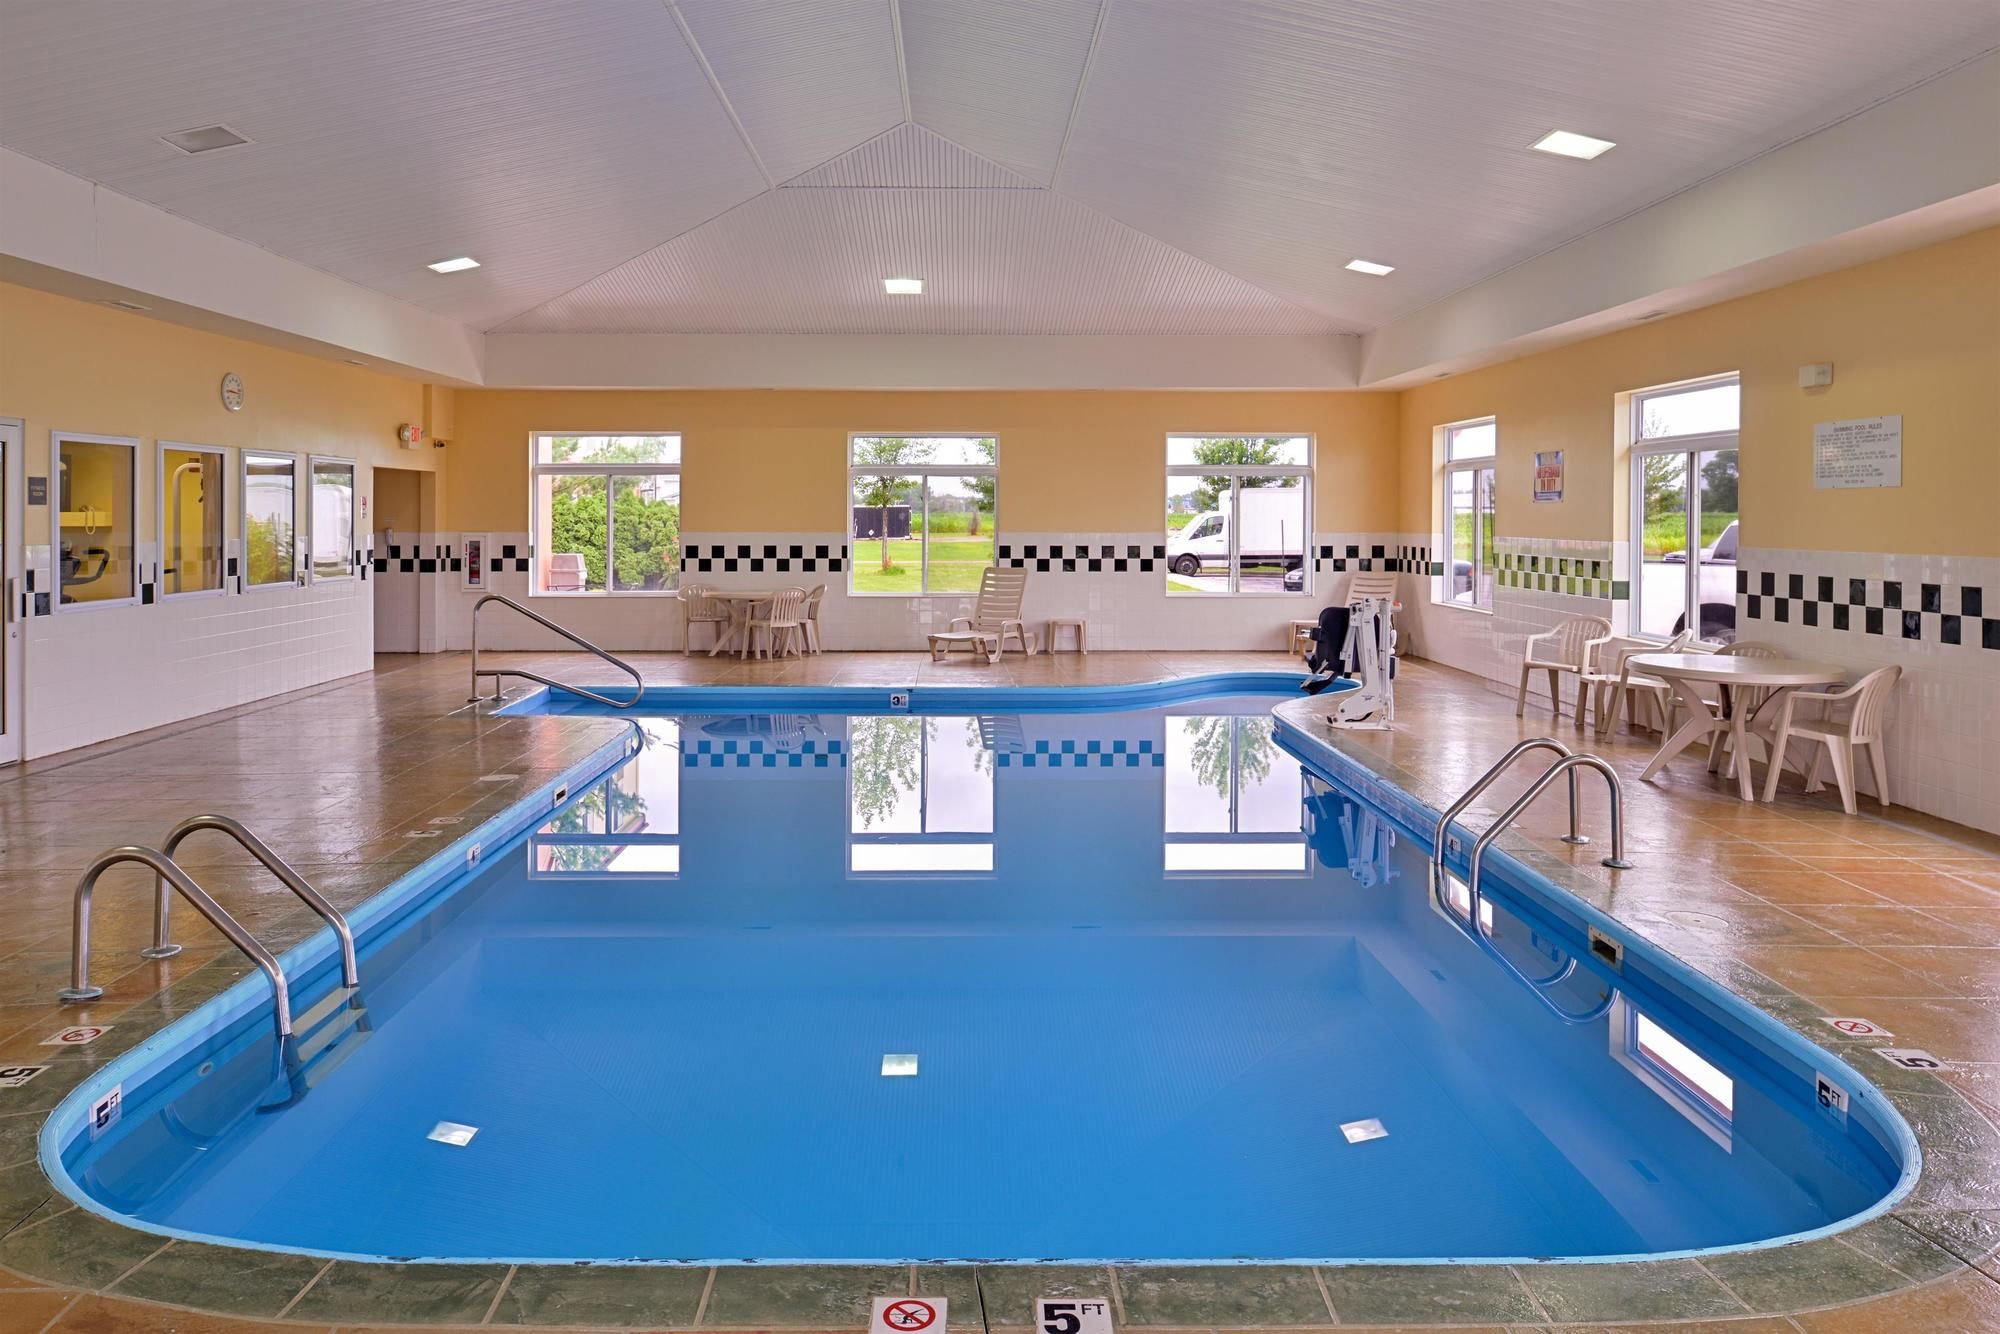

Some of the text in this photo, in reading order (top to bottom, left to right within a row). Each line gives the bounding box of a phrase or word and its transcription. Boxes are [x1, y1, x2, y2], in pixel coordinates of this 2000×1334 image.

[1868, 422, 1882, 430] RULES
[892, 695, 901, 706] 3
[1894, 1057, 1939, 1068] 5
[0, 1067, 42, 1078] 5
[1817, 1080, 1841, 1108] 5 FT
[96, 1092, 119, 1128] 5 FT
[1043, 1303, 1105, 1334] 5 FT
